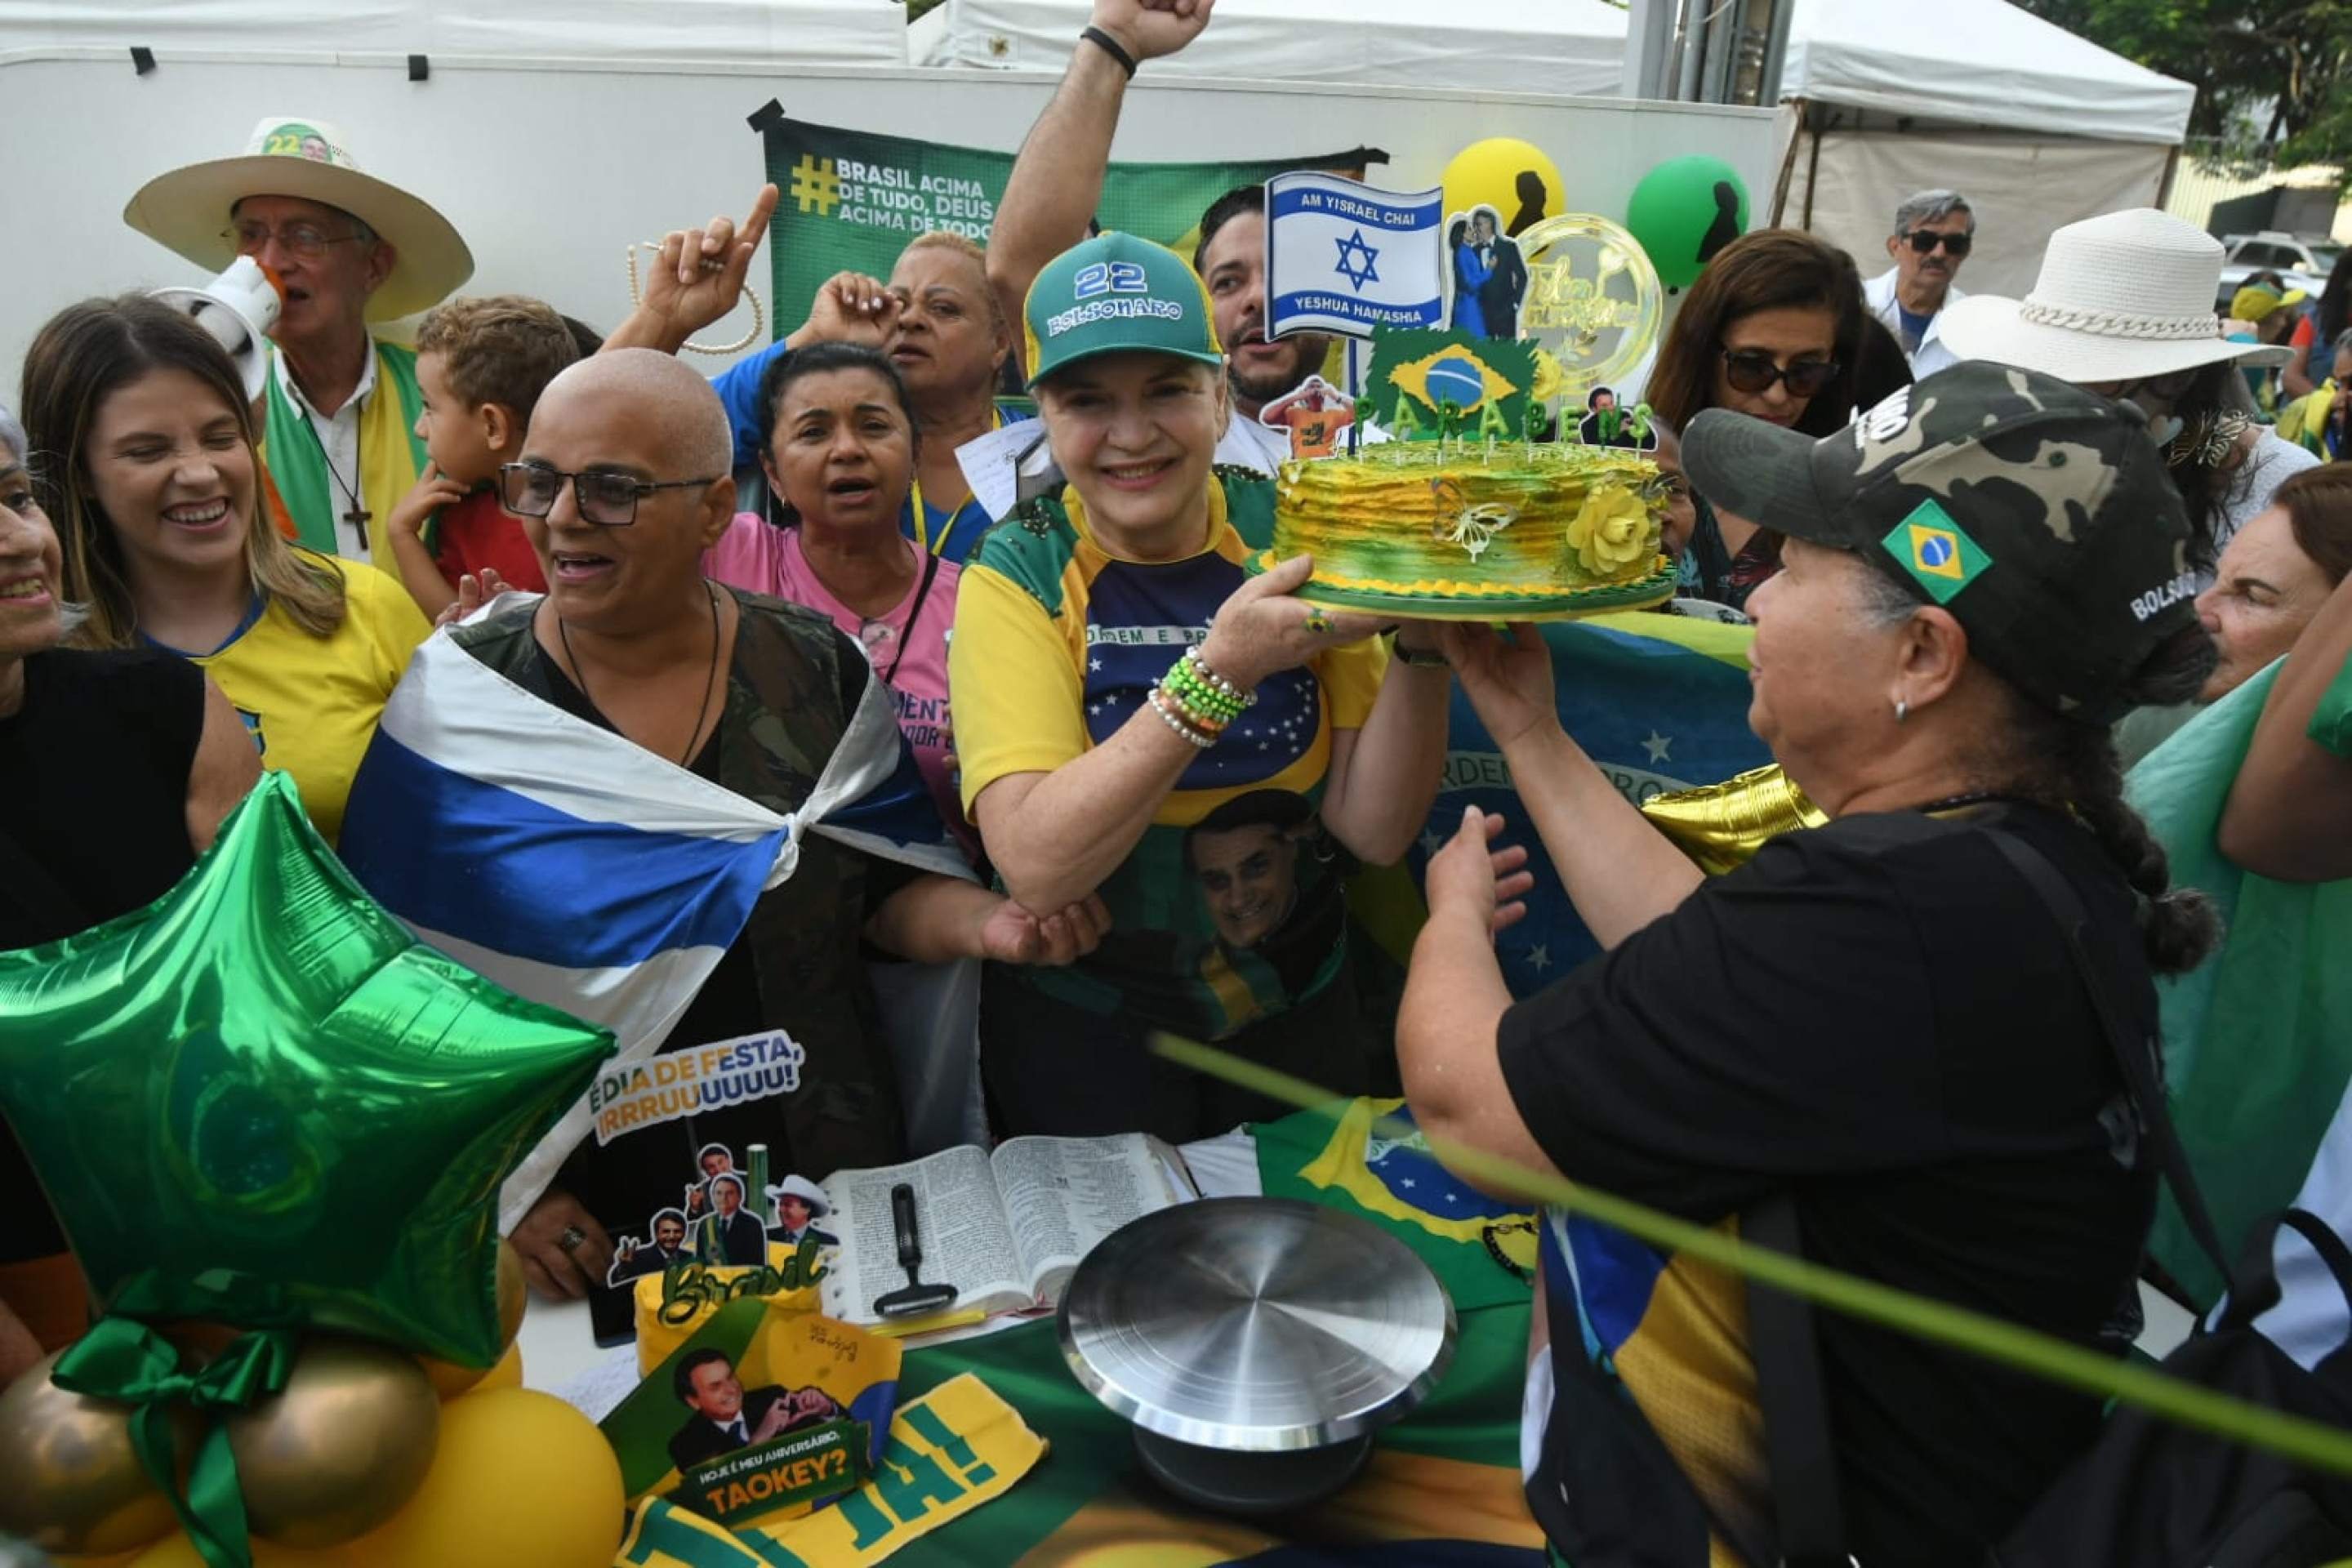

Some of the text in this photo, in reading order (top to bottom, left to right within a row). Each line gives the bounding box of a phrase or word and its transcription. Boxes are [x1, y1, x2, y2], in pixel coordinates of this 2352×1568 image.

[268, 132, 301, 155] 22
[837, 158, 984, 198] BRASIL ACIMA
[838, 204, 906, 230] ACIMA
[911, 216, 935, 234] DE
[839, 183, 994, 220] DE TUDO, DEUS
[1302, 194, 1414, 225] AM YISRAEL CHAI
[1075, 261, 1147, 300] 22
[1047, 297, 1183, 336] BOLSONARO
[1294, 296, 1349, 312] YESHUA
[1157, 629, 1169, 643] E
[603, 1067, 652, 1102] DIA
[654, 1055, 693, 1085] DE
[700, 1036, 800, 1075] FESTA,
[657, 1236, 828, 1326] Brasil
[699, 1466, 730, 1485] HOJE
[739, 1453, 763, 1468] MEU
[706, 1449, 847, 1514] TAOKEY?
